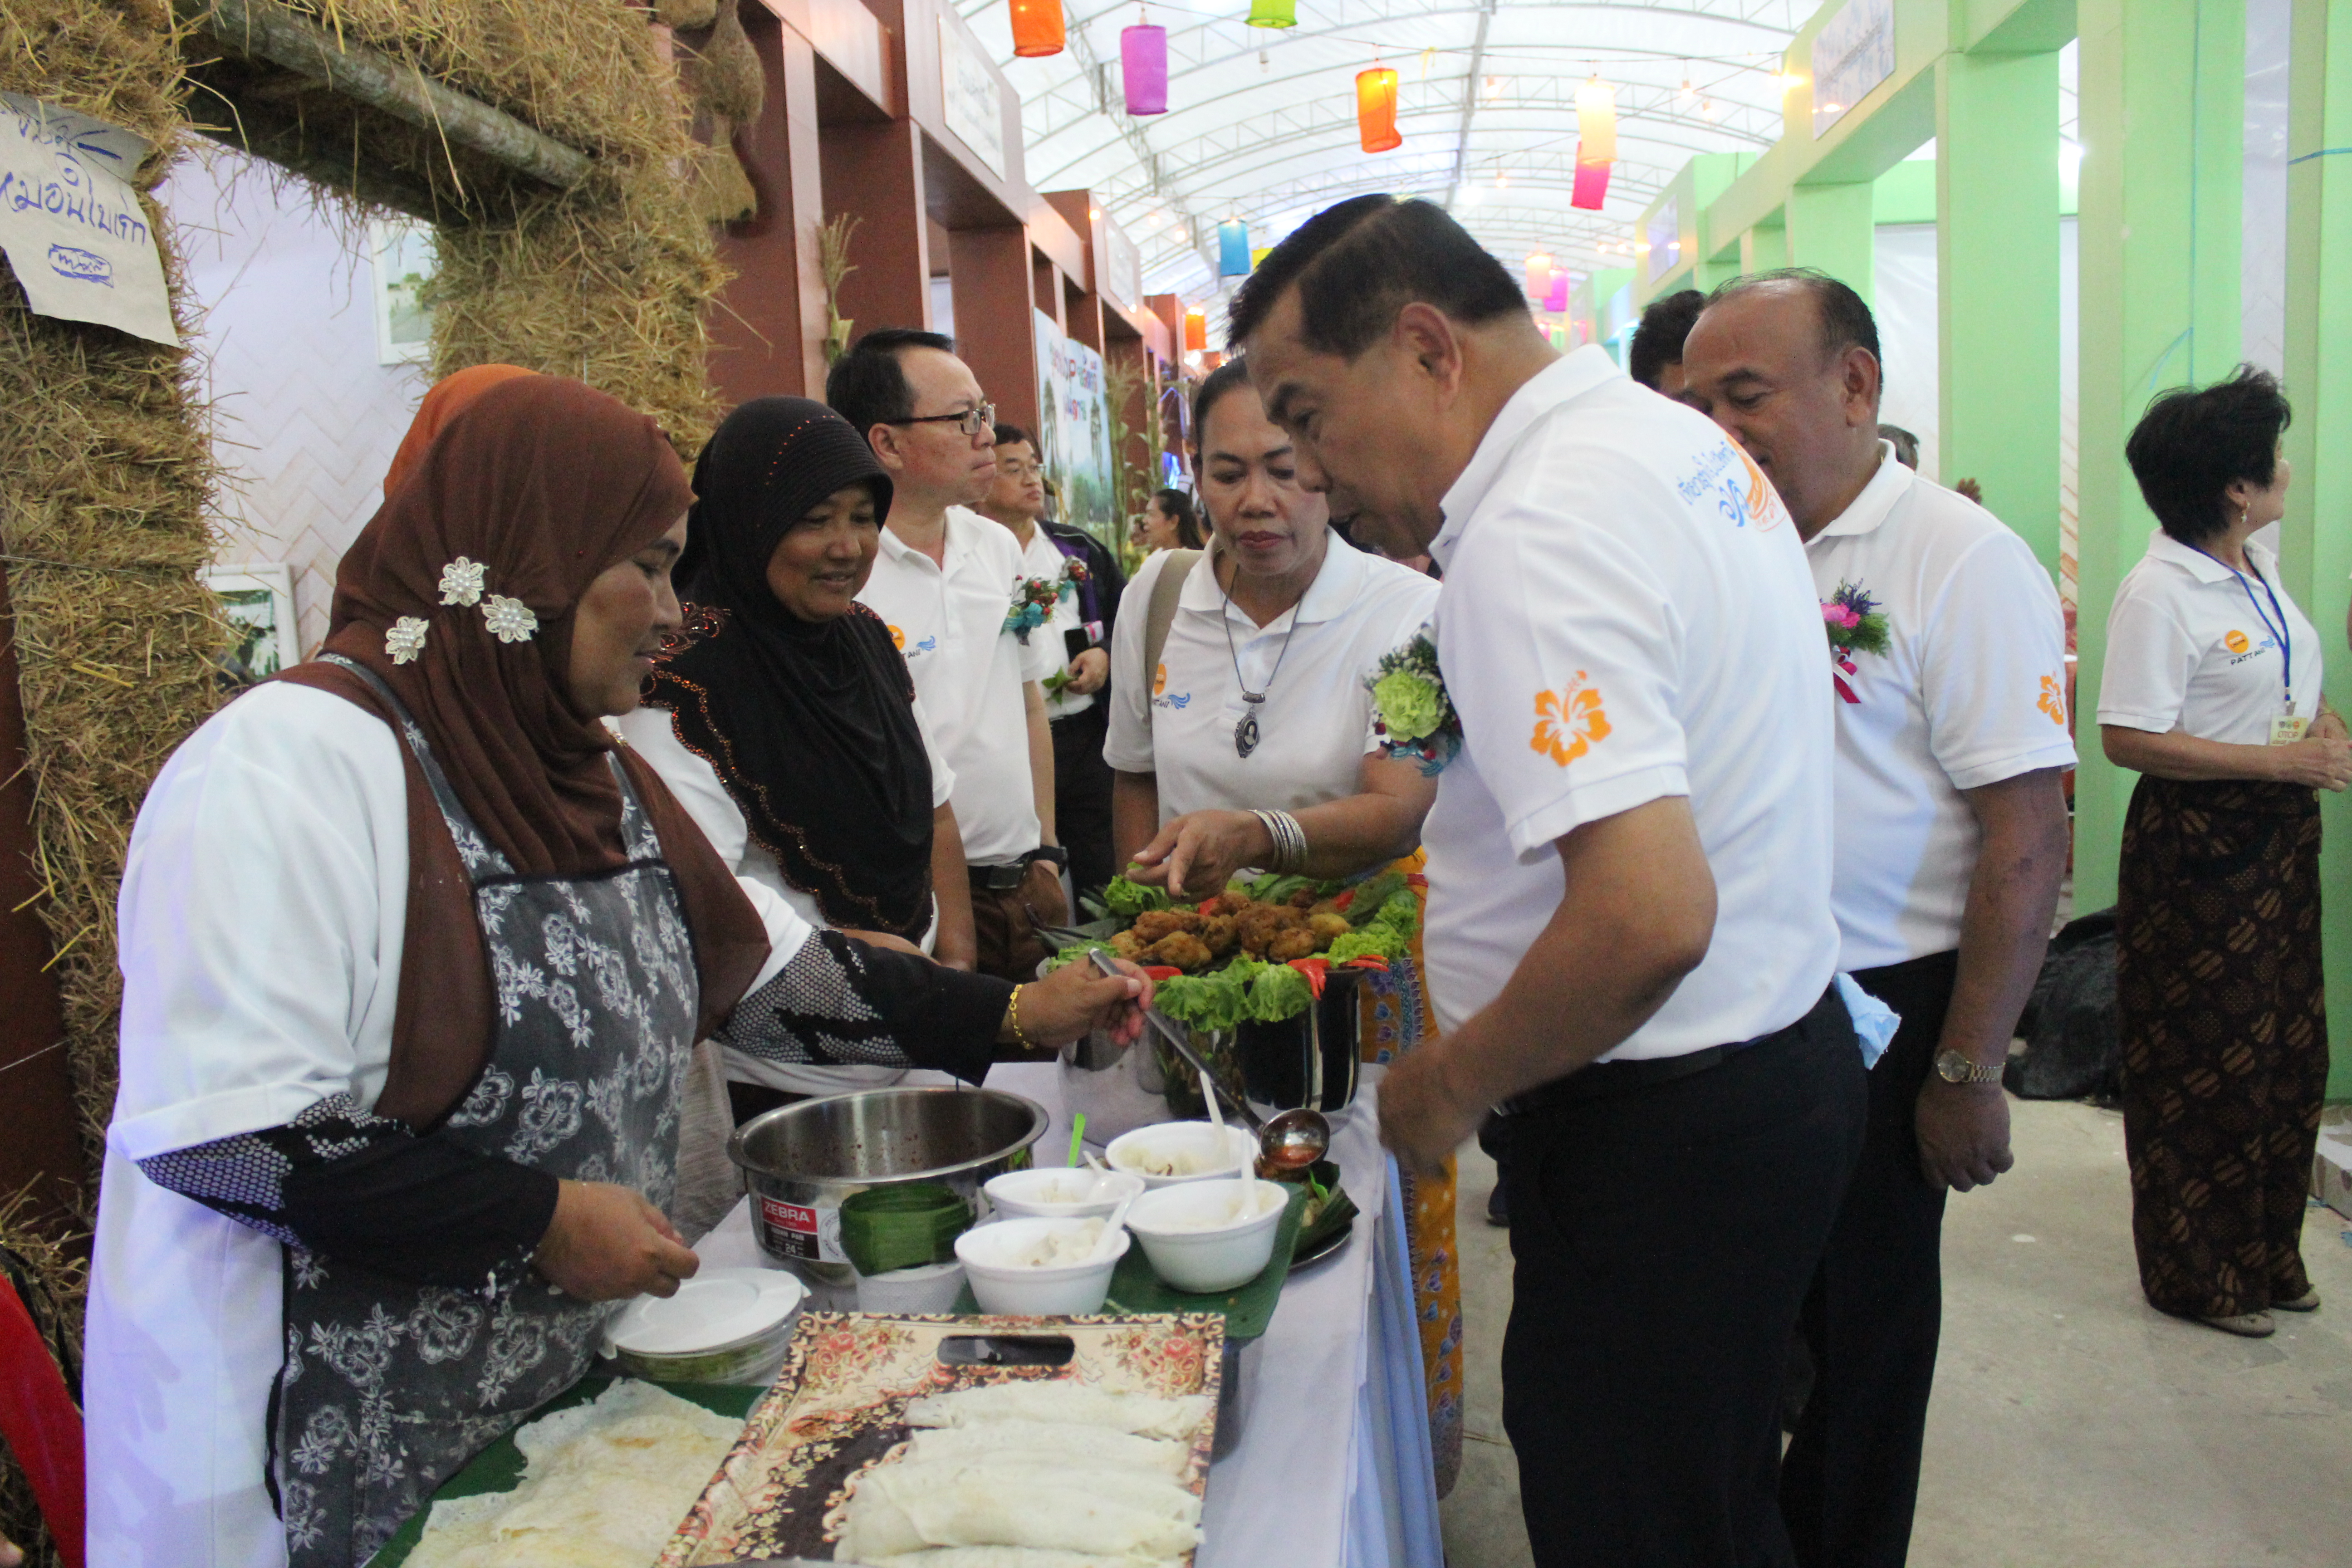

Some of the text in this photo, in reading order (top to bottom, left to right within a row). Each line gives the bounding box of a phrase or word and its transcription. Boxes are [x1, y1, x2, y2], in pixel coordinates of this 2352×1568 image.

[2230, 647, 2266, 666] PATTANI
[764, 1201, 810, 1223] ZEBRA
[785, 1243, 796, 1254] 24
